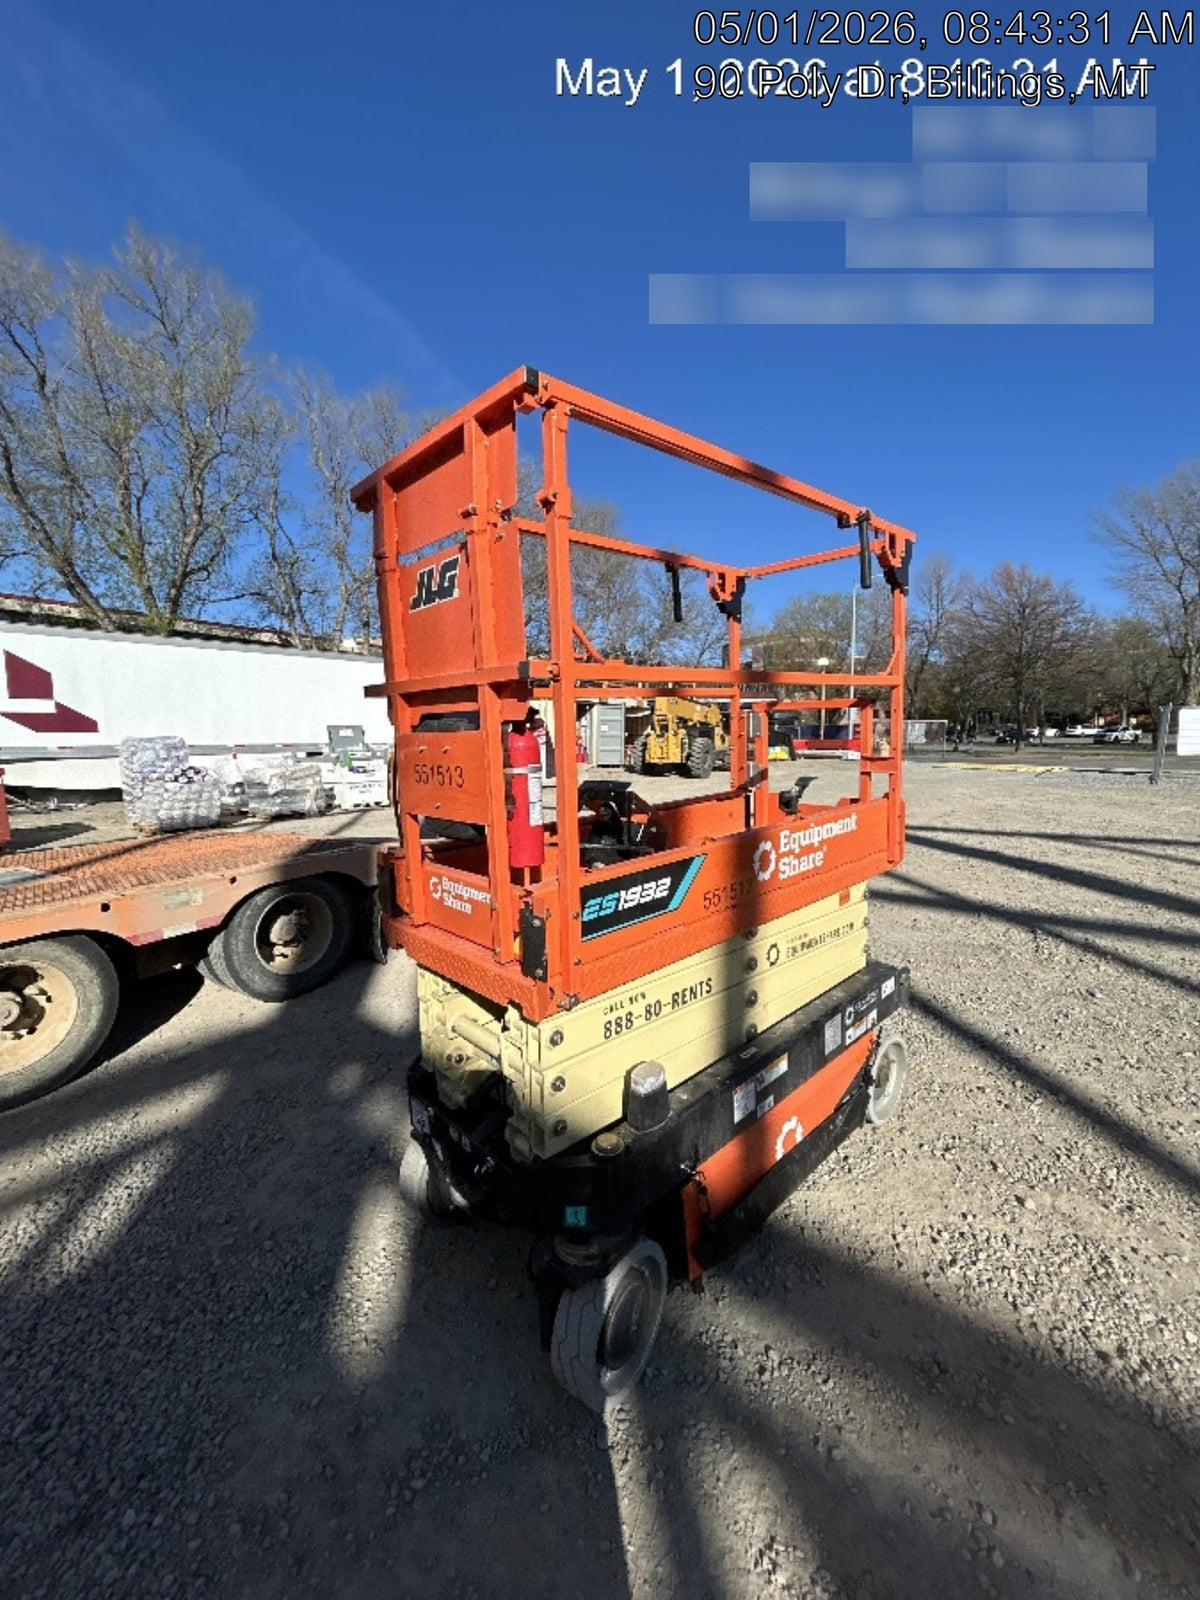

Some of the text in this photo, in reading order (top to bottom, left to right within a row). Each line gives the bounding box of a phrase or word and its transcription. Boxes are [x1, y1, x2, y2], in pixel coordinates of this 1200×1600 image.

[409, 554, 461, 613] JLG
[413, 763, 465, 789] 551513
[779, 812, 858, 853] Equipment
[778, 850, 824, 881] Share
[582, 876, 672, 922] ES1932
[703, 879, 753, 910] 551513
